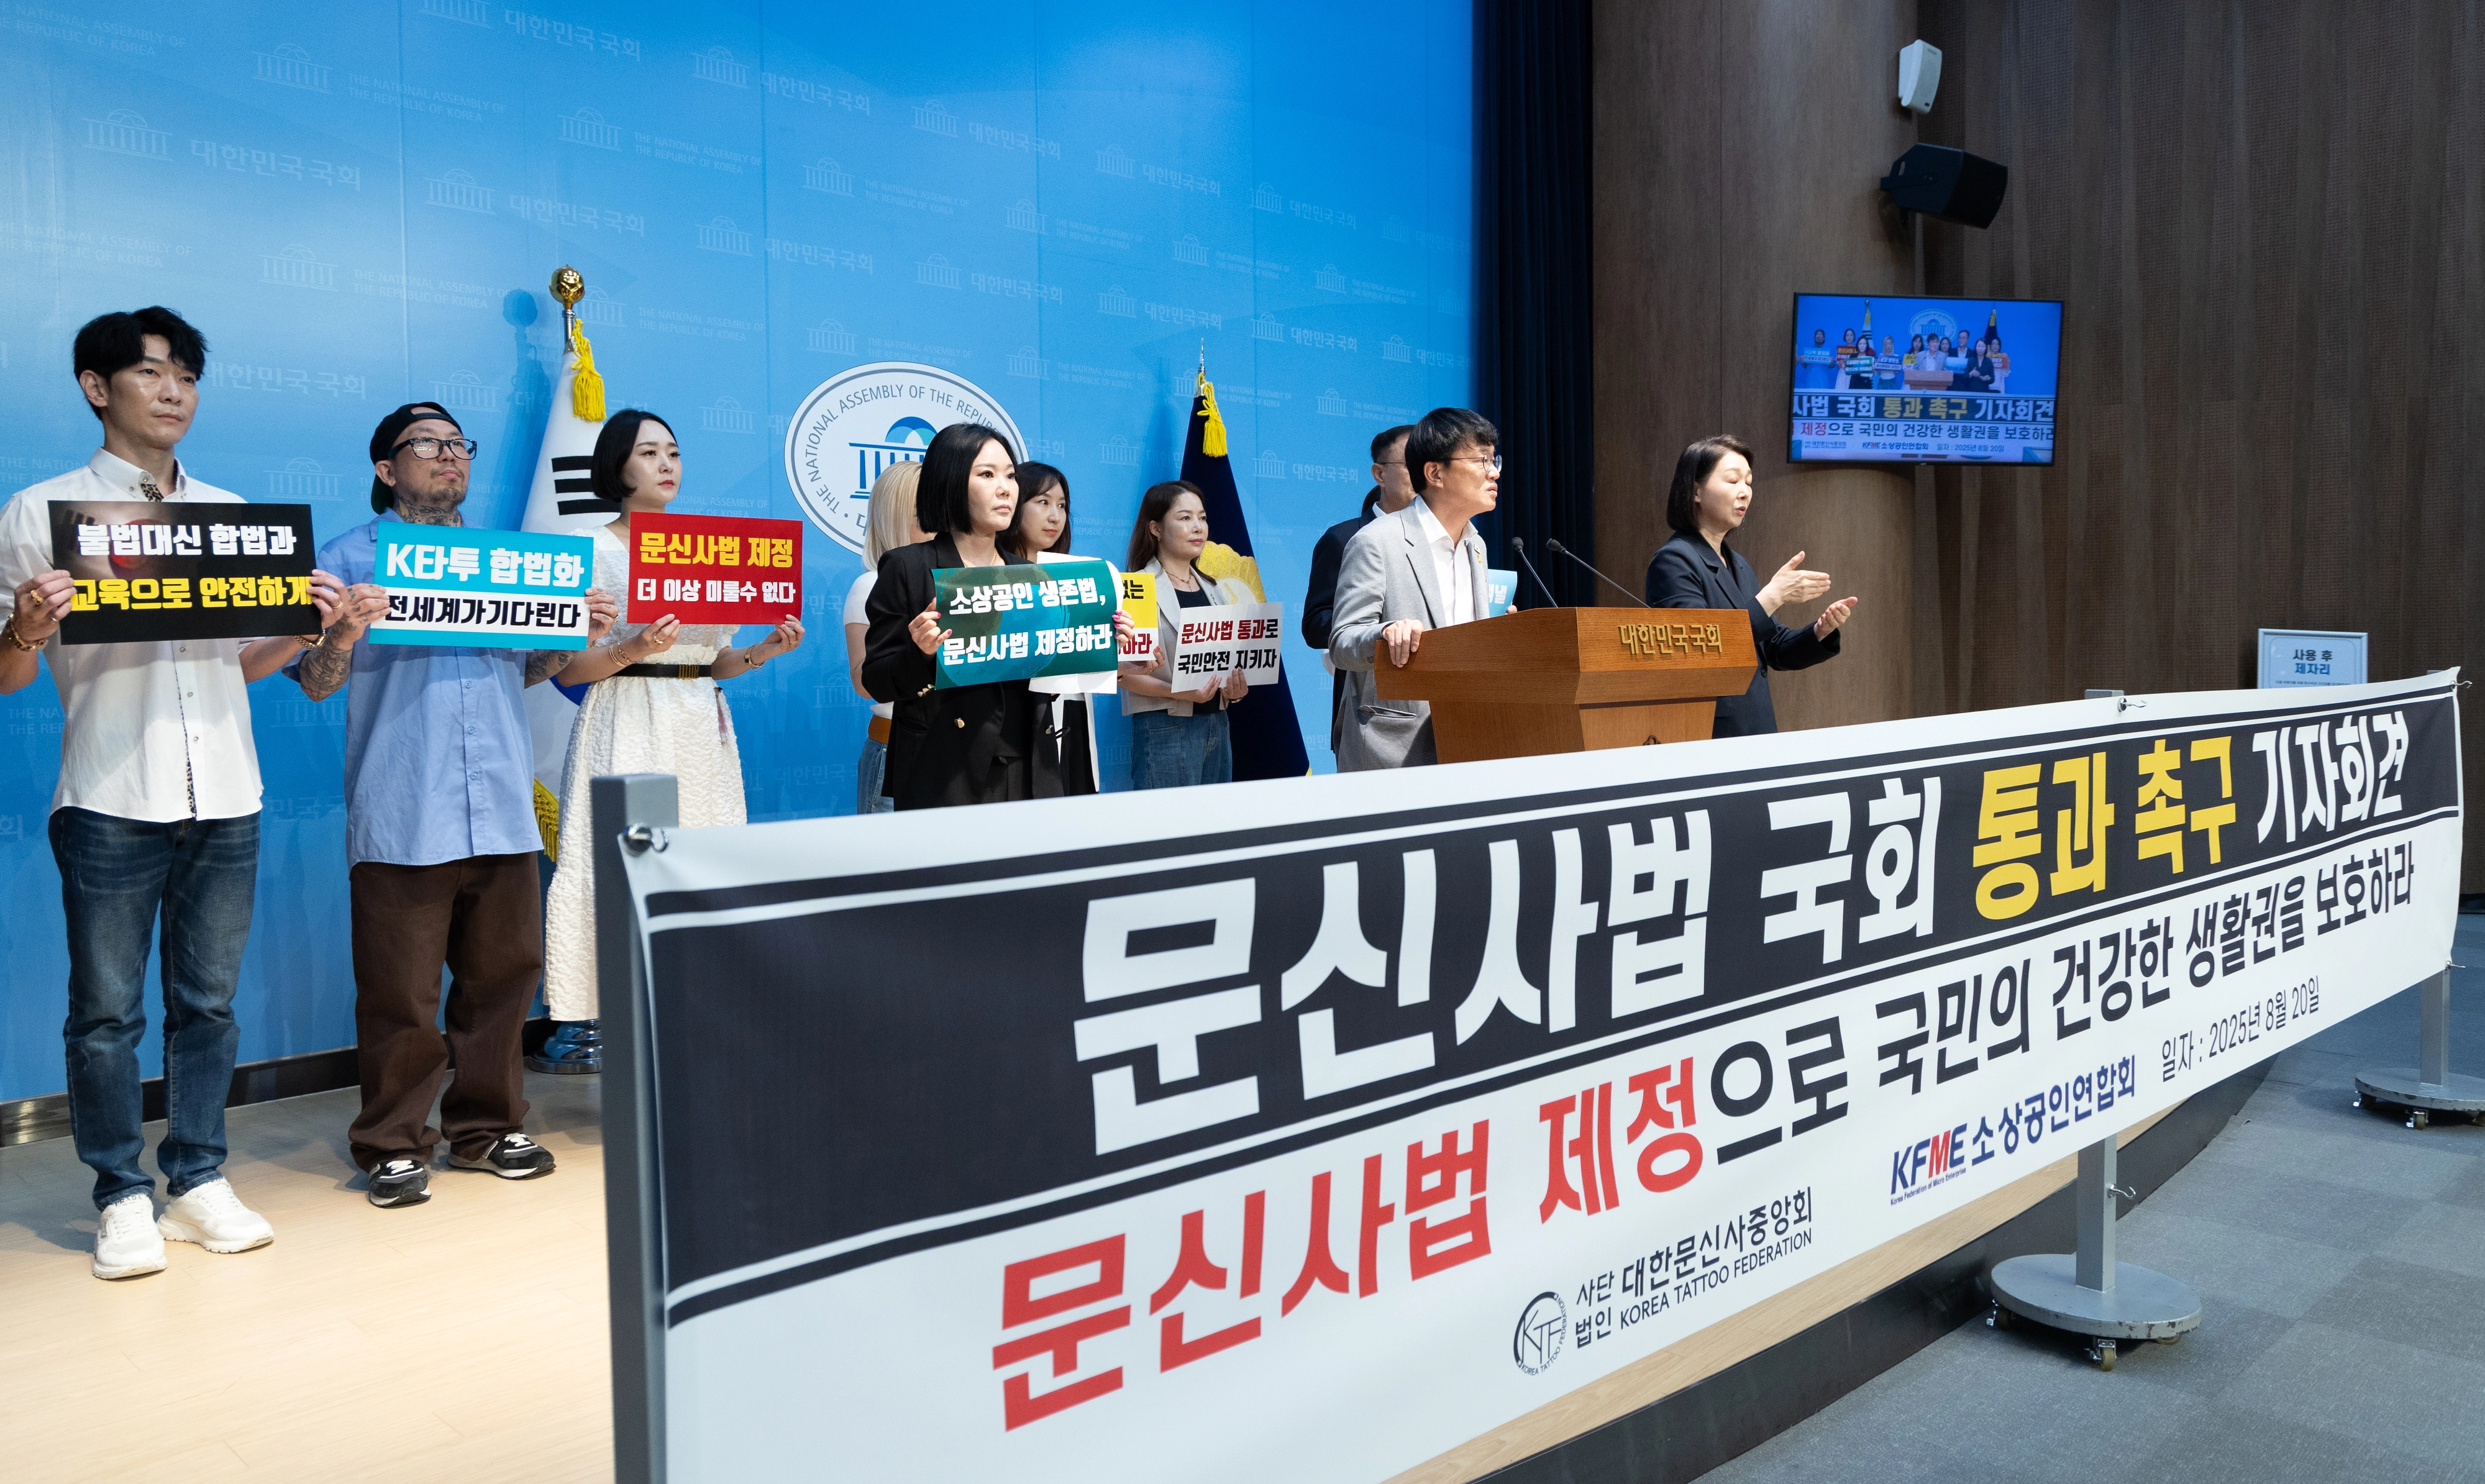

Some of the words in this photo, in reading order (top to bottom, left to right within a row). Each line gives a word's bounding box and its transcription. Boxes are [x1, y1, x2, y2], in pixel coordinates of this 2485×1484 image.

[839, 384, 904, 413] ASSEMBLY
[909, 385, 925, 398] OF
[929, 388, 953, 407] THE
[1837, 396, 1876, 417] 국회
[1883, 397, 1923, 419] 통과
[1928, 397, 1967, 420] 촉구
[1974, 399, 2054, 422] 기자회견
[806, 408, 839, 483] NATIONAL
[1801, 422, 1854, 436] 제정으로
[1859, 422, 1898, 437] 국민의
[1904, 423, 1943, 438] 건강한
[1947, 425, 2000, 439] 생활권을
[816, 485, 841, 514] THE
[78, 523, 202, 556] 불법대신
[209, 524, 297, 555] 합법과
[640, 532, 740, 566] 문신사법
[747, 537, 793, 568] 제정
[386, 544, 480, 581] K타투
[490, 547, 585, 588] 합법화
[70, 578, 192, 611] 교육으로
[199, 576, 312, 608] 안전하게
[637, 578, 657, 601] 더
[663, 579, 701, 601] 이상
[706, 580, 757, 603] 미룰수
[762, 581, 796, 603] 없다
[949, 583, 1034, 615] 소상공인
[1038, 578, 1106, 608] 생존법,
[385, 595, 581, 628] 전세계가기다린다
[942, 632, 1028, 666] 문신사법
[1034, 624, 1113, 657] 제정하라
[1181, 620, 1233, 644] 문신사법
[1237, 619, 1279, 640] 통과로
[1178, 650, 1230, 675] 국민안전
[1234, 649, 1277, 670] 지키자
[2293, 649, 2317, 661] 사용
[2321, 650, 2333, 662] 후
[2295, 663, 2330, 675] 제자리
[1074, 809, 1712, 1156] 문신사법
[1760, 776, 1941, 965] 국회
[1972, 752, 2114, 920] 통과
[2135, 735, 2236, 874] 촉구
[2252, 711, 2409, 844] 기자회견
[2162, 1029, 2194, 1083] 일자
[2209, 1001, 2261, 1059] 2025년
[2266, 989, 2286, 1032] 8월
[2292, 975, 2319, 1021] 20일
[992, 1119, 1492, 1432] 문신사법
[1539, 1016, 1849, 1225] 제정으로
[1874, 958, 2031, 1095] 국민의
[2053, 916, 2174, 1041] 건강한
[2186, 876, 2305, 988] 생활권을
[2317, 840, 2414, 935] 보호하라
[1890, 1123, 1967, 1195] KFME
[1971, 1054, 2136, 1166] 소상공인연합회
[1890, 1196, 1904, 1206] Korea
[1904, 1185, 1926, 1200] Federation
[1928, 1181, 1932, 1189] of
[1933, 1177, 1945, 1187] Micro
[1945, 1168, 1966, 1181] Enterprise
[1576, 1271, 1615, 1307] 사단
[1622, 1186, 1812, 1298] 대한문신사중앙회
[1575, 1306, 1612, 1349] 법인
[1621, 1291, 1670, 1329] KOREA
[1674, 1265, 1729, 1304] TATTOO
[1734, 1227, 1812, 1278] FEDERATION
[1521, 1363, 1539, 1376] KOREA
[1541, 1347, 1561, 1373] TATTOO
[1557, 1297, 1567, 1345] FEDERATION
